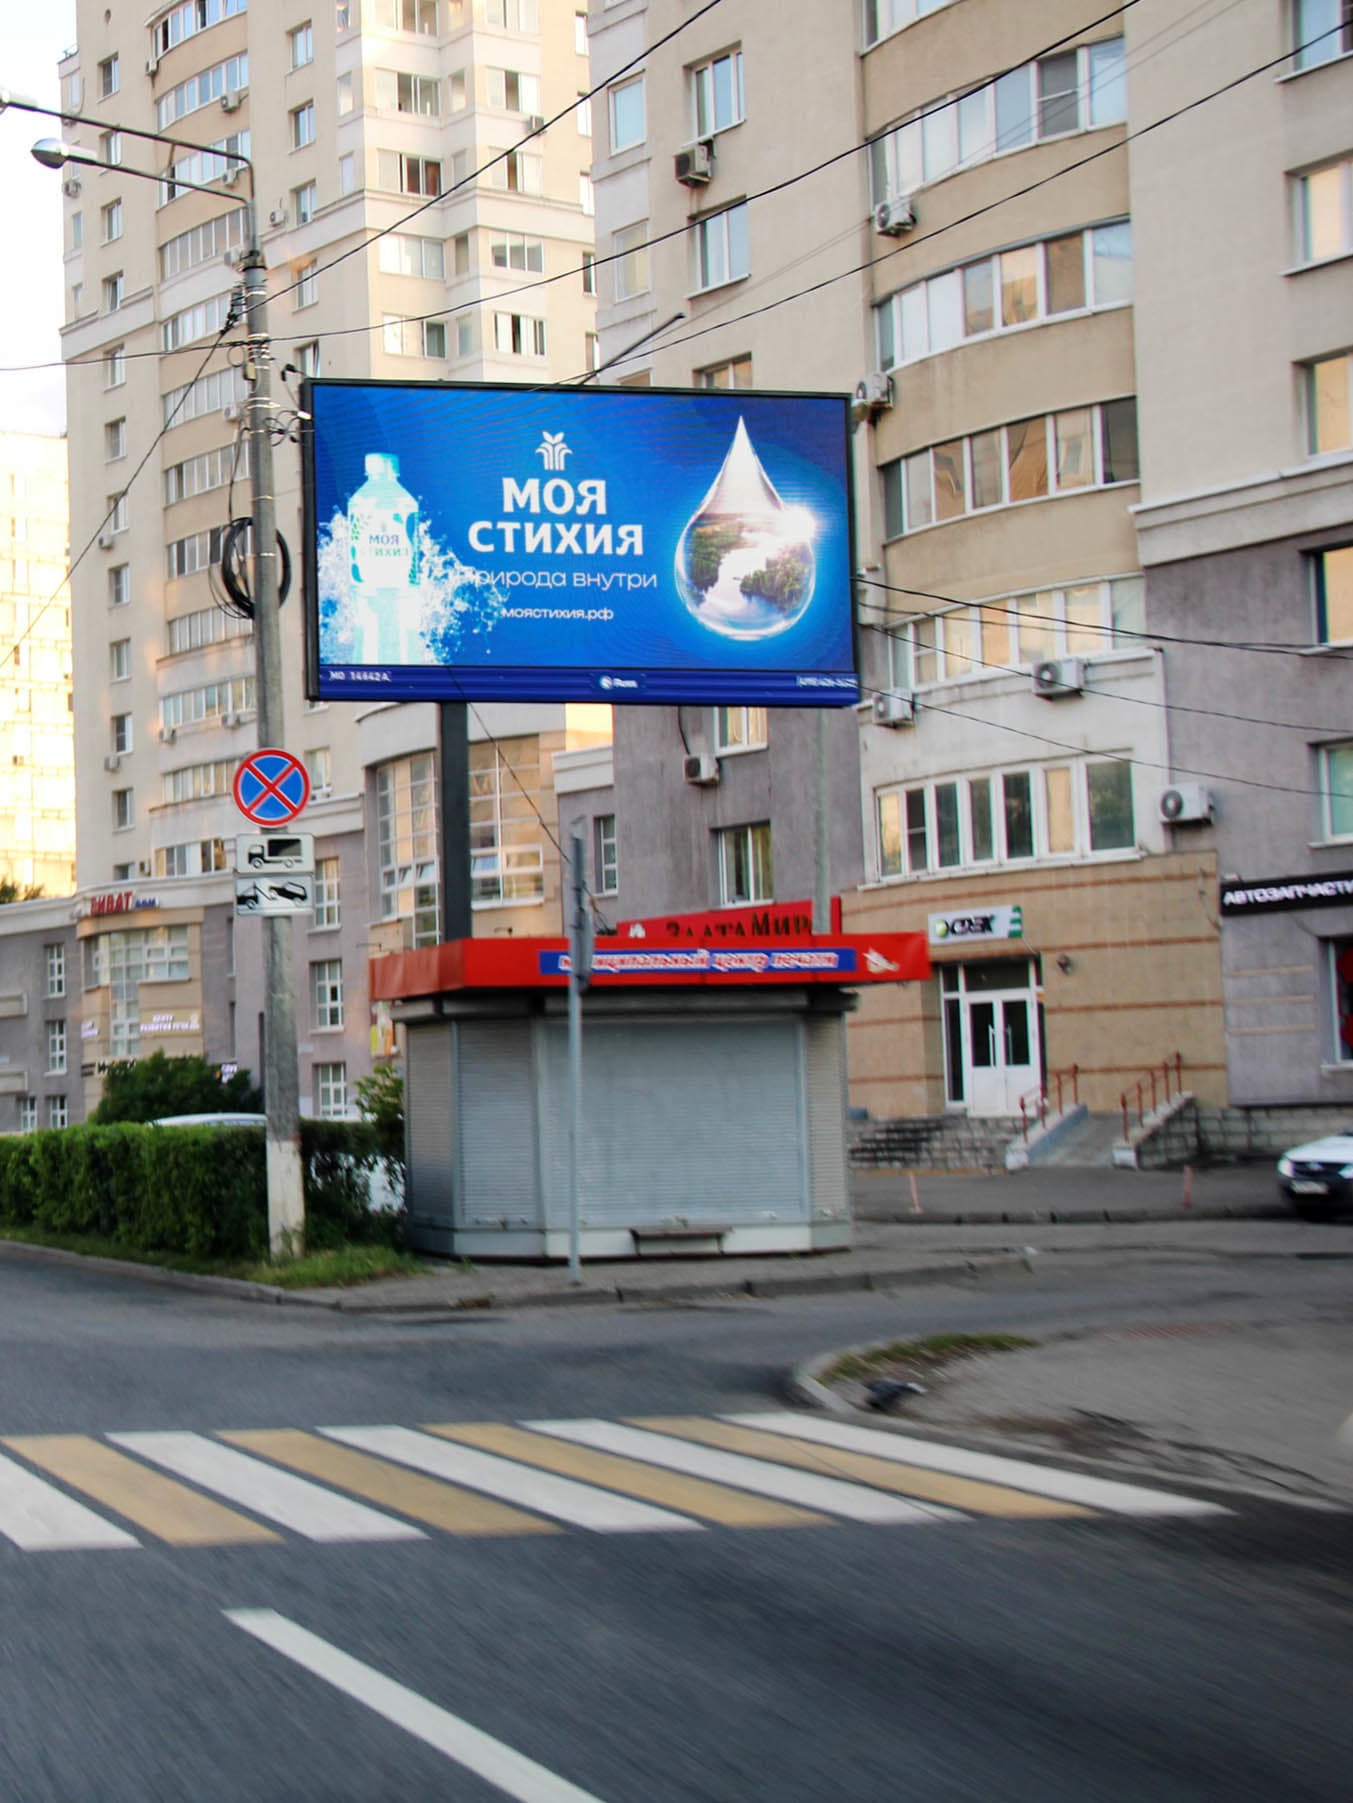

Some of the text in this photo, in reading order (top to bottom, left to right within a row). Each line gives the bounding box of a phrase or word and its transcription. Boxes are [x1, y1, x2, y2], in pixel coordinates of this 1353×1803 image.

[502, 477, 607, 515] МОЯ
[369, 534, 400, 545] МОЯ
[468, 520, 644, 556] СТИХИЯ
[573, 571, 658, 592] внутри
[501, 606, 615, 621] моястихия.рф
